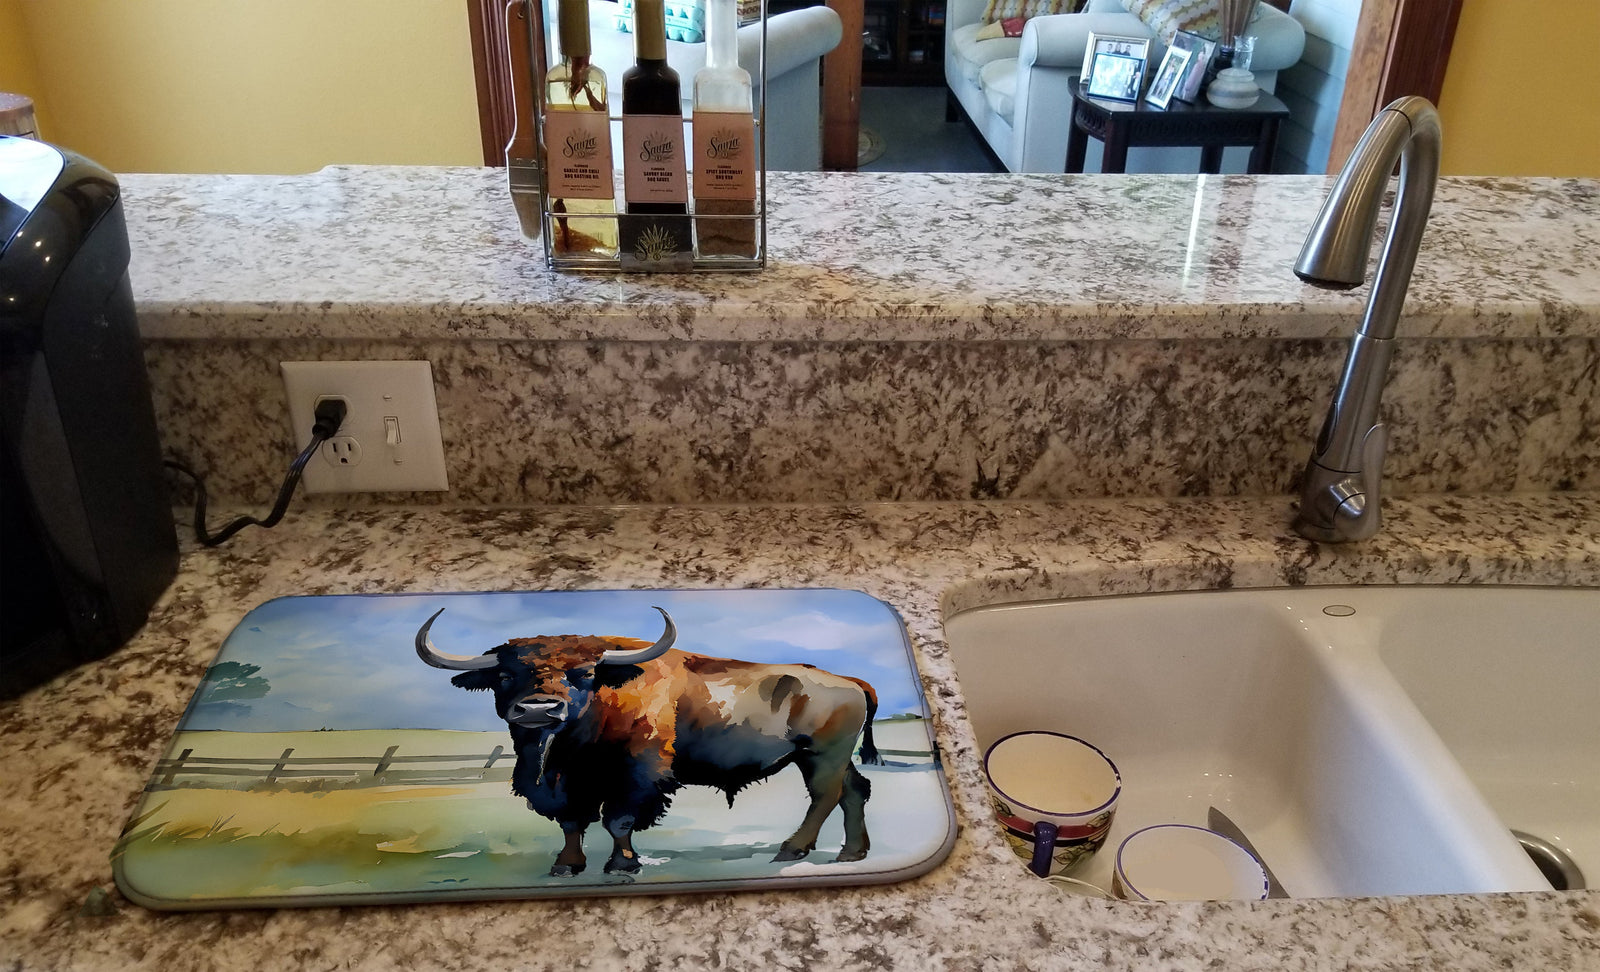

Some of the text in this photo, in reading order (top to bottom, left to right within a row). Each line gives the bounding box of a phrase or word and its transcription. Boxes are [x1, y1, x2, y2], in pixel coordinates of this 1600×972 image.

[563, 136, 597, 158] Sauza
[640, 140, 673, 162] Sauza
[707, 137, 740, 159] Sauza
